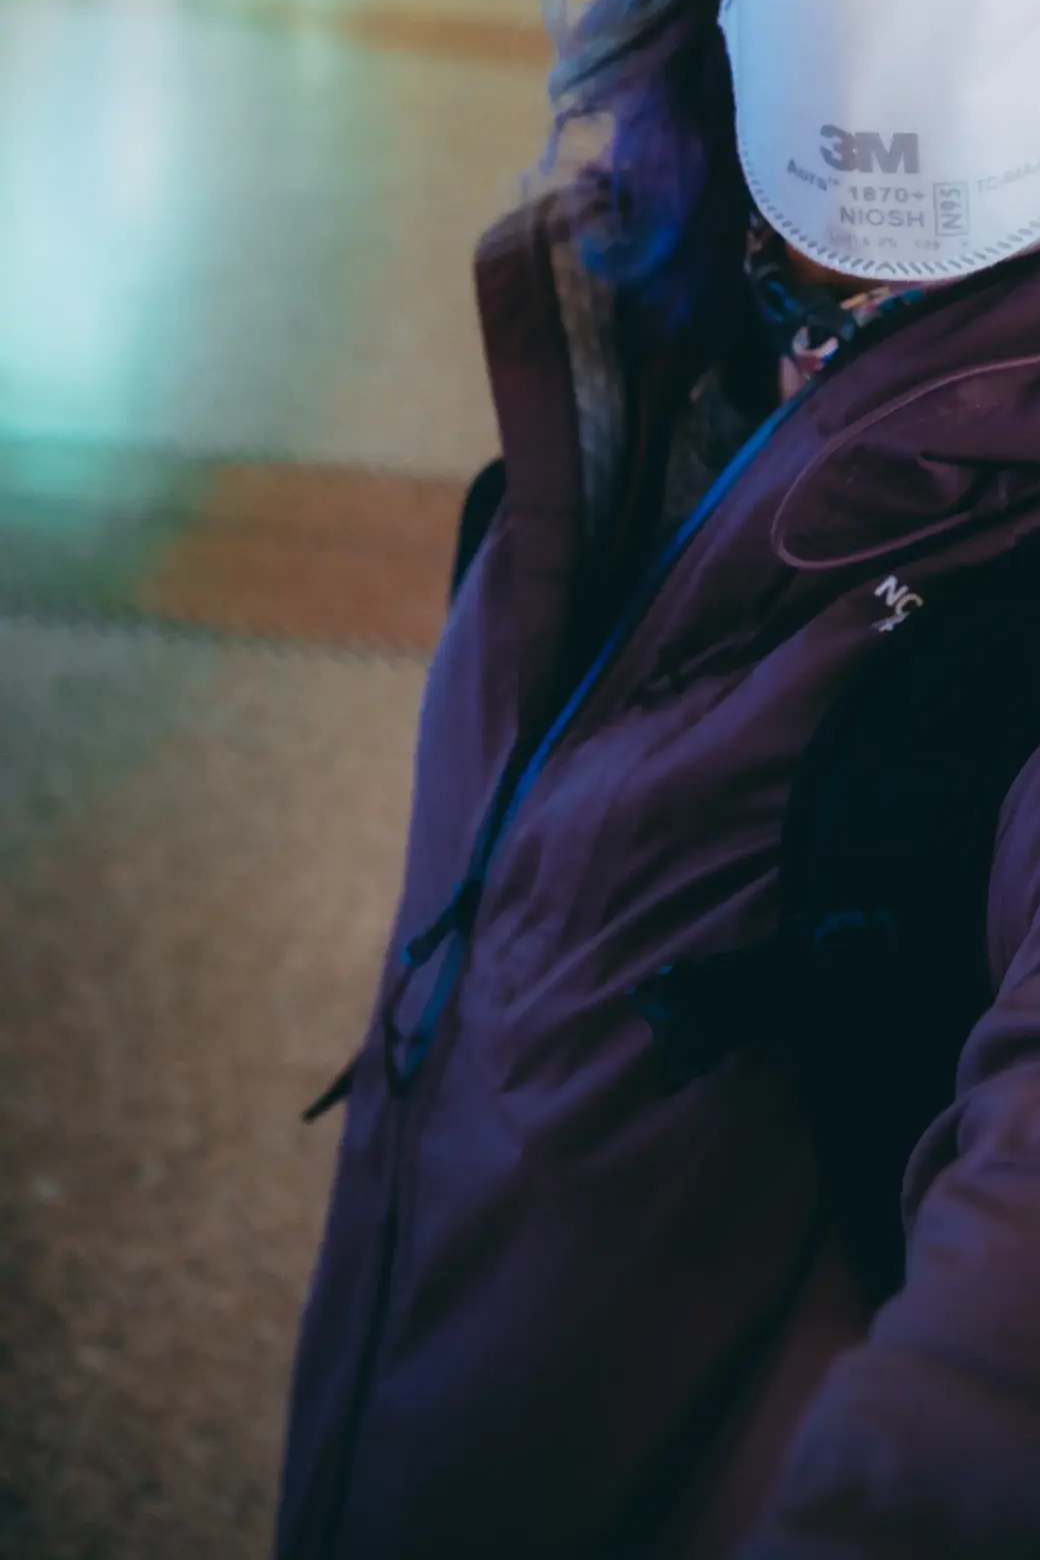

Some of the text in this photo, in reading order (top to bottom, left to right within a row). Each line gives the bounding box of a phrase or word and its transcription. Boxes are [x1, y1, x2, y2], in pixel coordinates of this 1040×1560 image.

[820, 124, 920, 174] 3M
[849, 186, 925, 203] 1870+
[939, 187, 964, 230] N95
[839, 205, 925, 227] NIOSH
